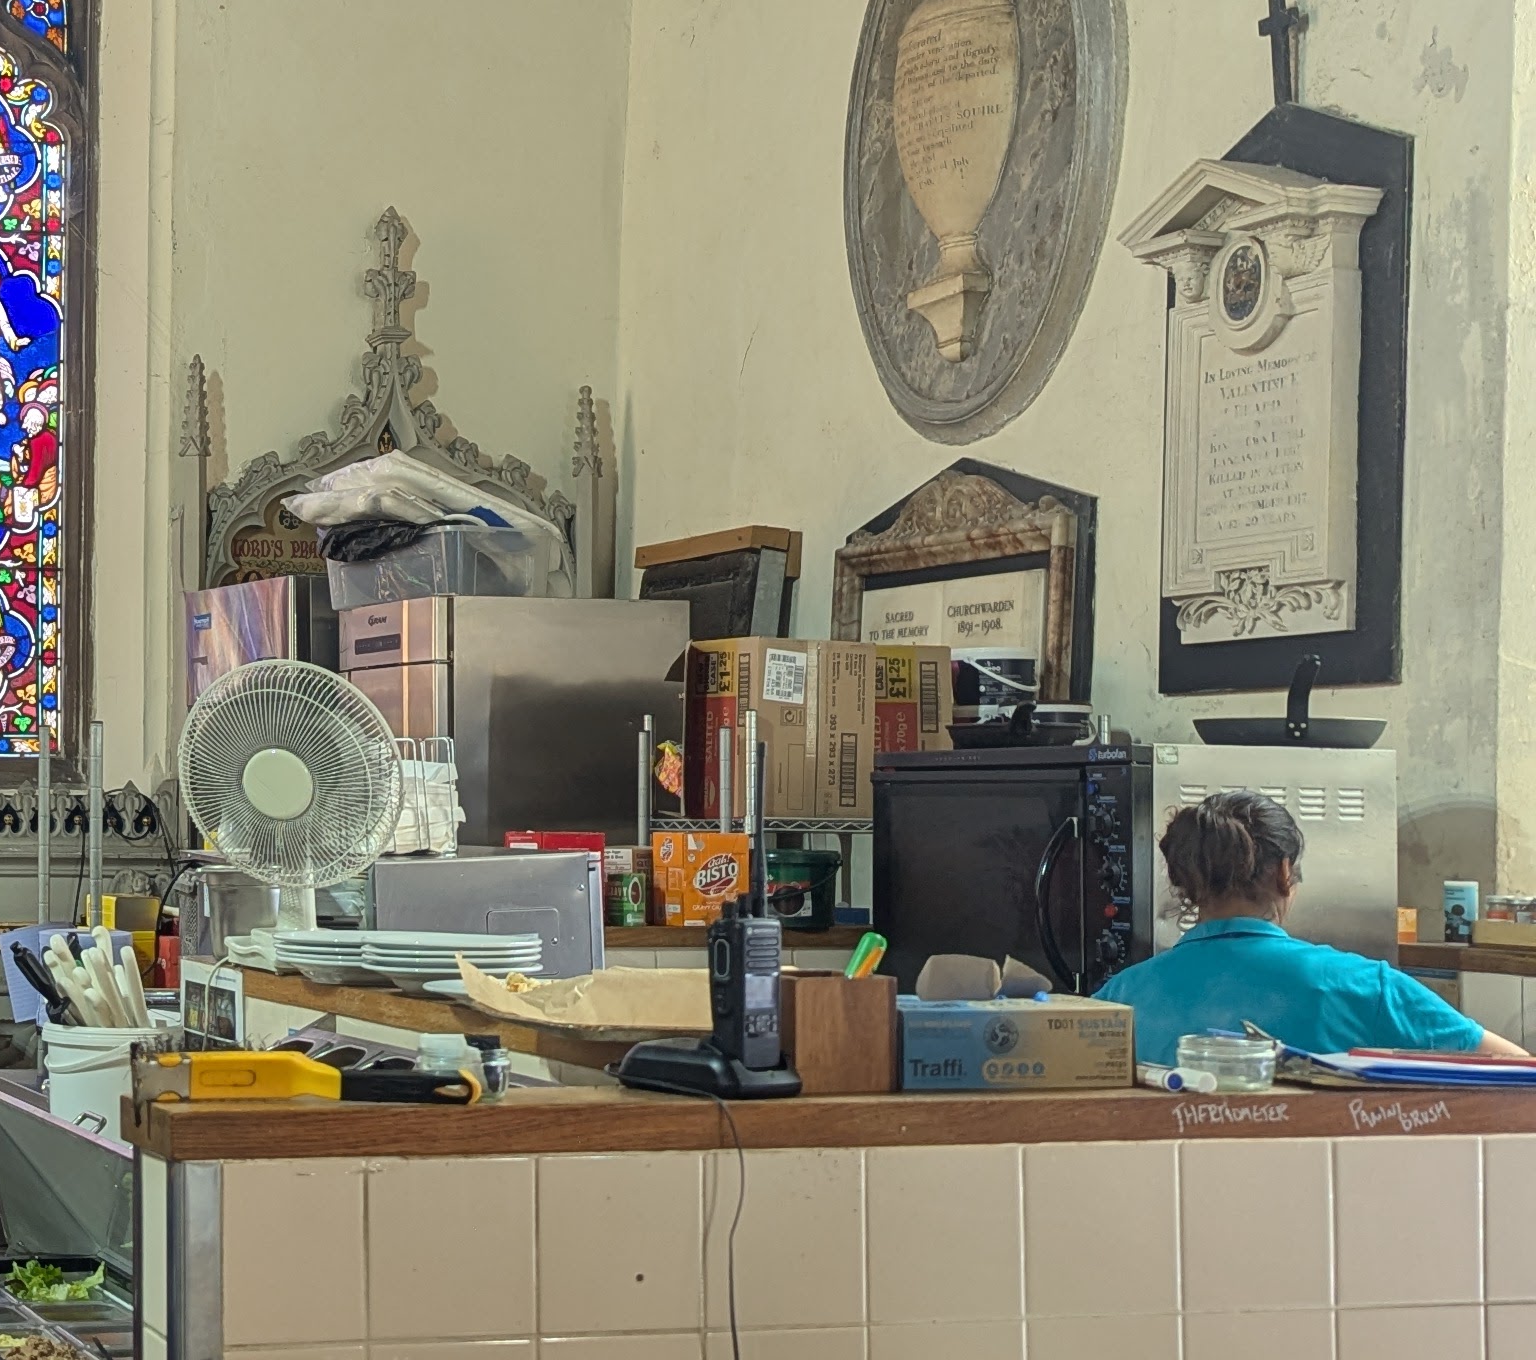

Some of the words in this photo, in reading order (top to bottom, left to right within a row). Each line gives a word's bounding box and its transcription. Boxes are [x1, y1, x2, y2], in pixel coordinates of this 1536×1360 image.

[231, 538, 284, 559] LORD'S
[885, 610, 915, 624] SACRED
[947, 599, 1015, 619] CHURCHWARDEN
[869, 630, 880, 642] TO
[881, 628, 896, 641] THE
[889, 657, 907, 699] £1.25
[695, 862, 738, 889] BISTO
